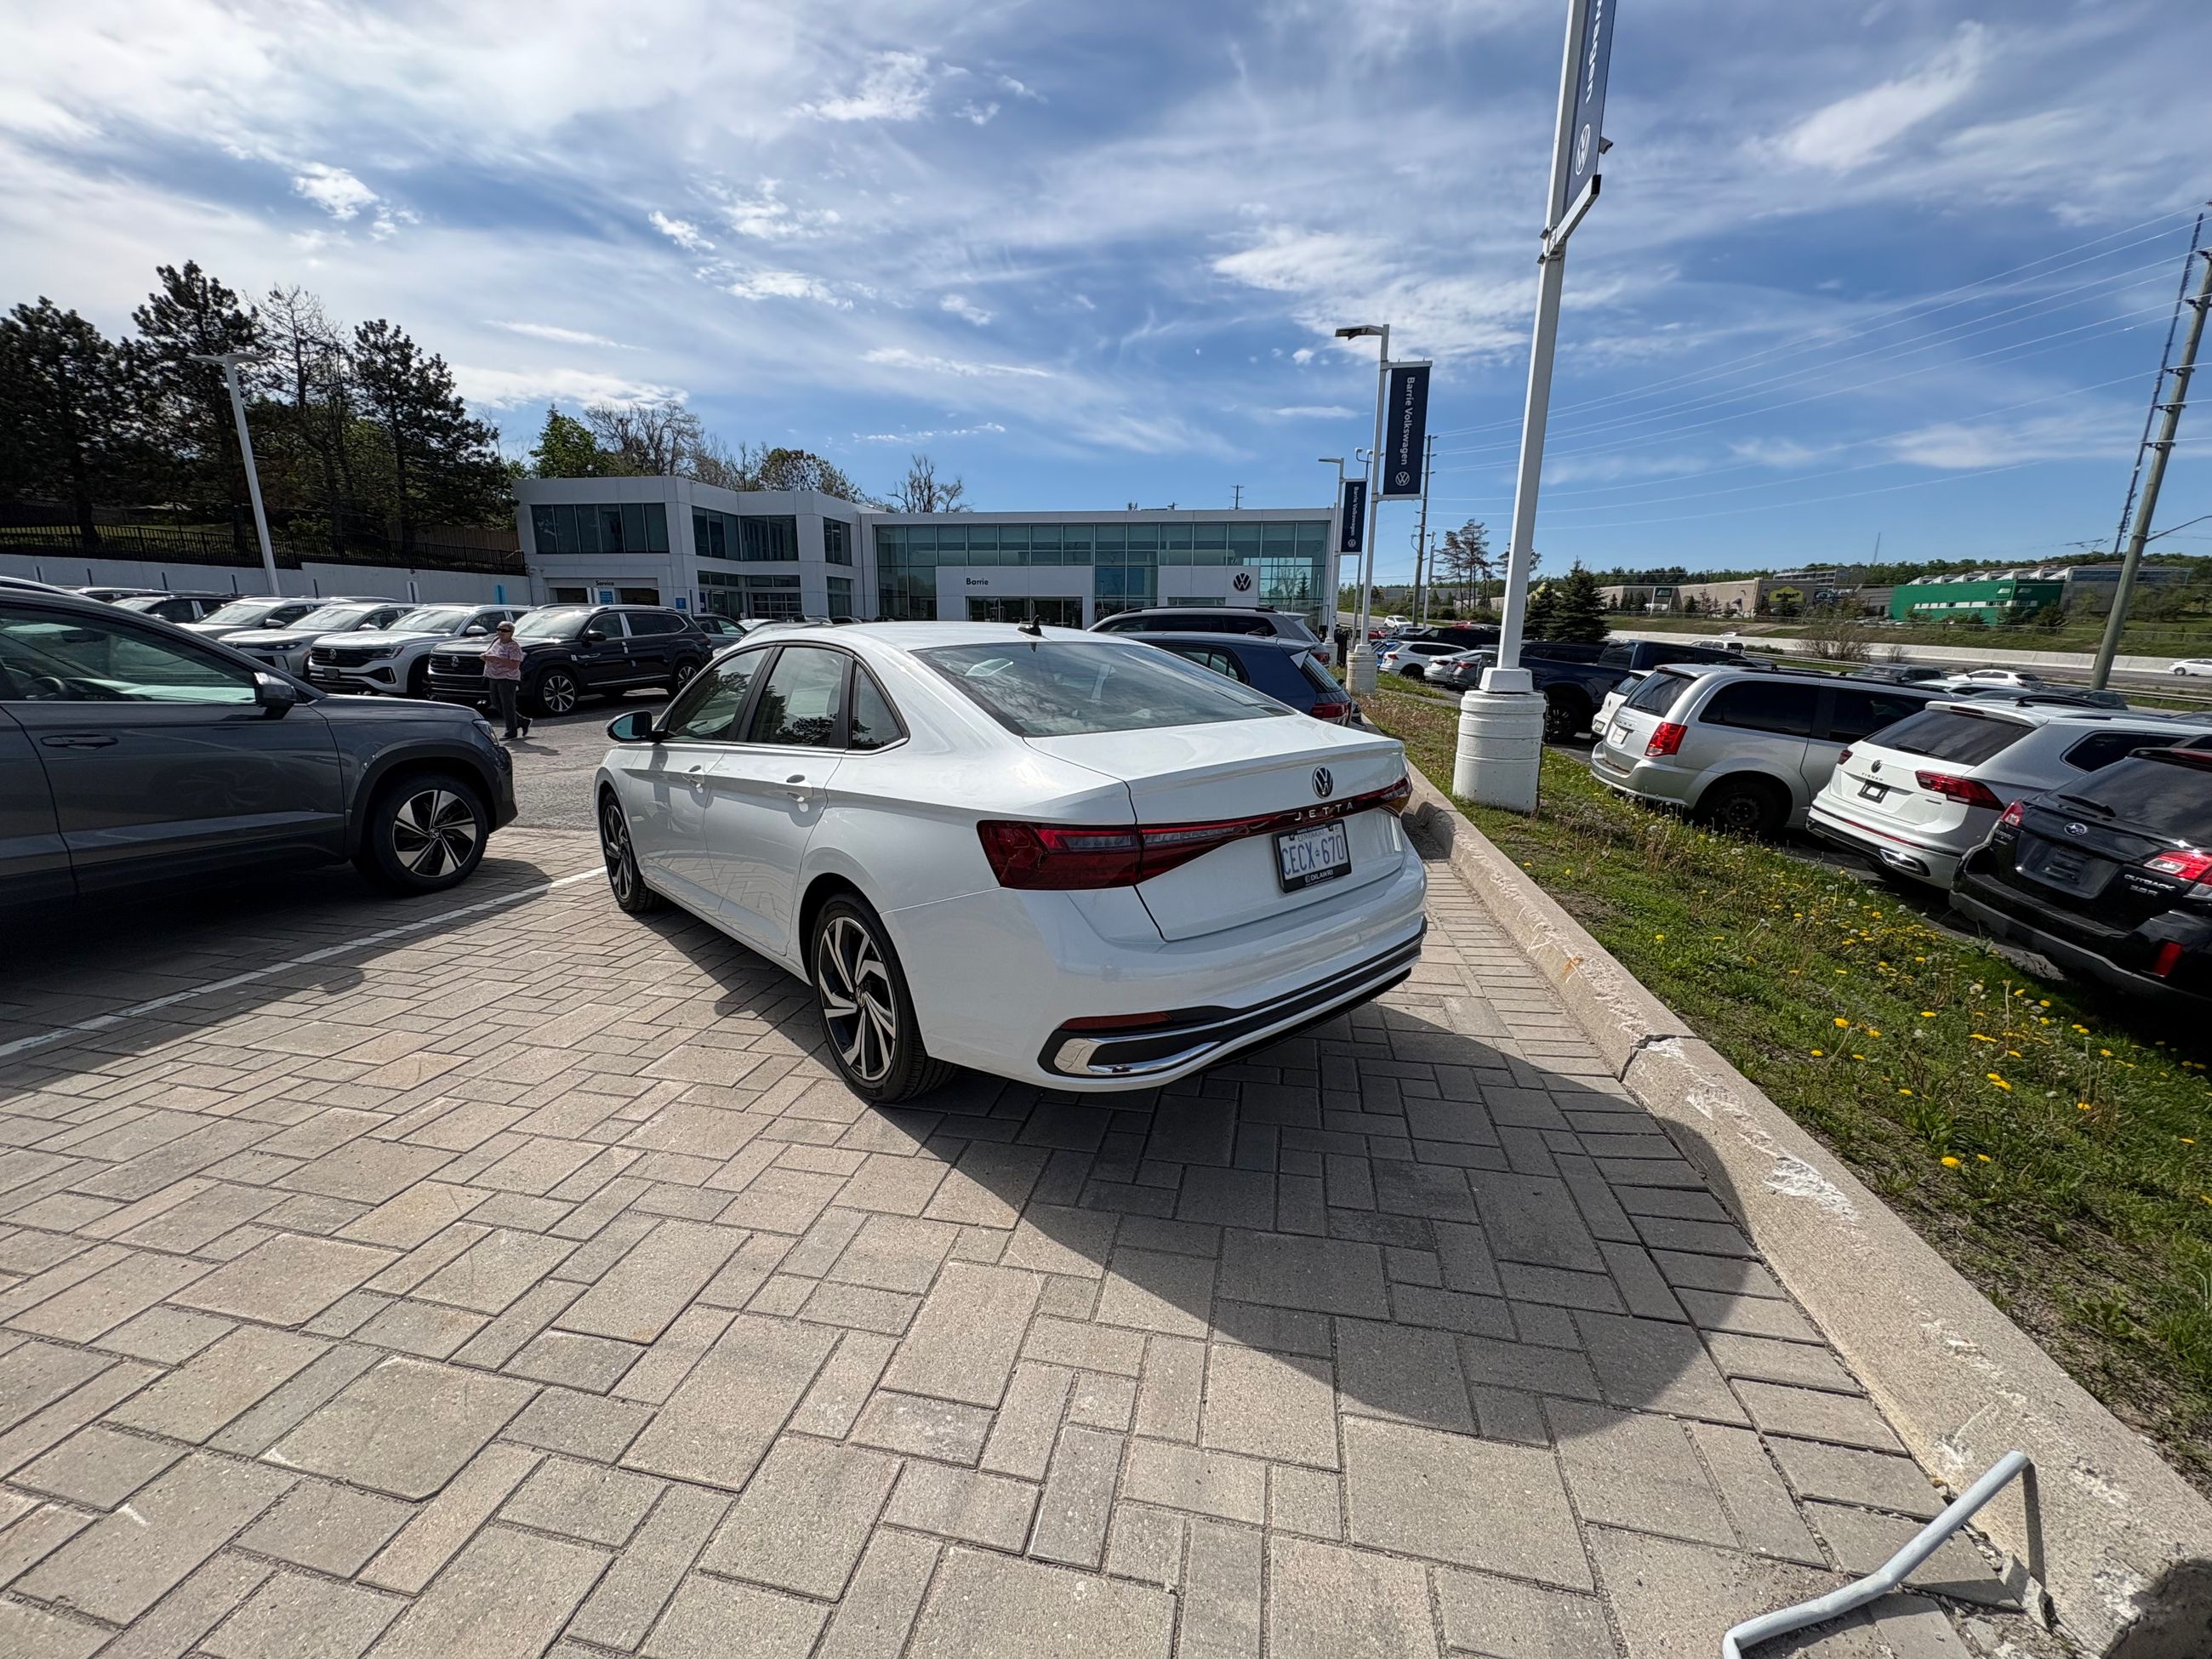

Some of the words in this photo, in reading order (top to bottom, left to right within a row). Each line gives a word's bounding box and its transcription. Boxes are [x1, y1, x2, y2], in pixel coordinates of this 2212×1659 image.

[1405, 377, 1416, 406] Barrie
[1400, 407, 1413, 465] Volkswagen
[1294, 801, 1354, 821] JETTA
[1281, 841, 1315, 875] CECX
[1320, 835, 1344, 864] 670
[2124, 874, 2176, 892] OUTBACK
